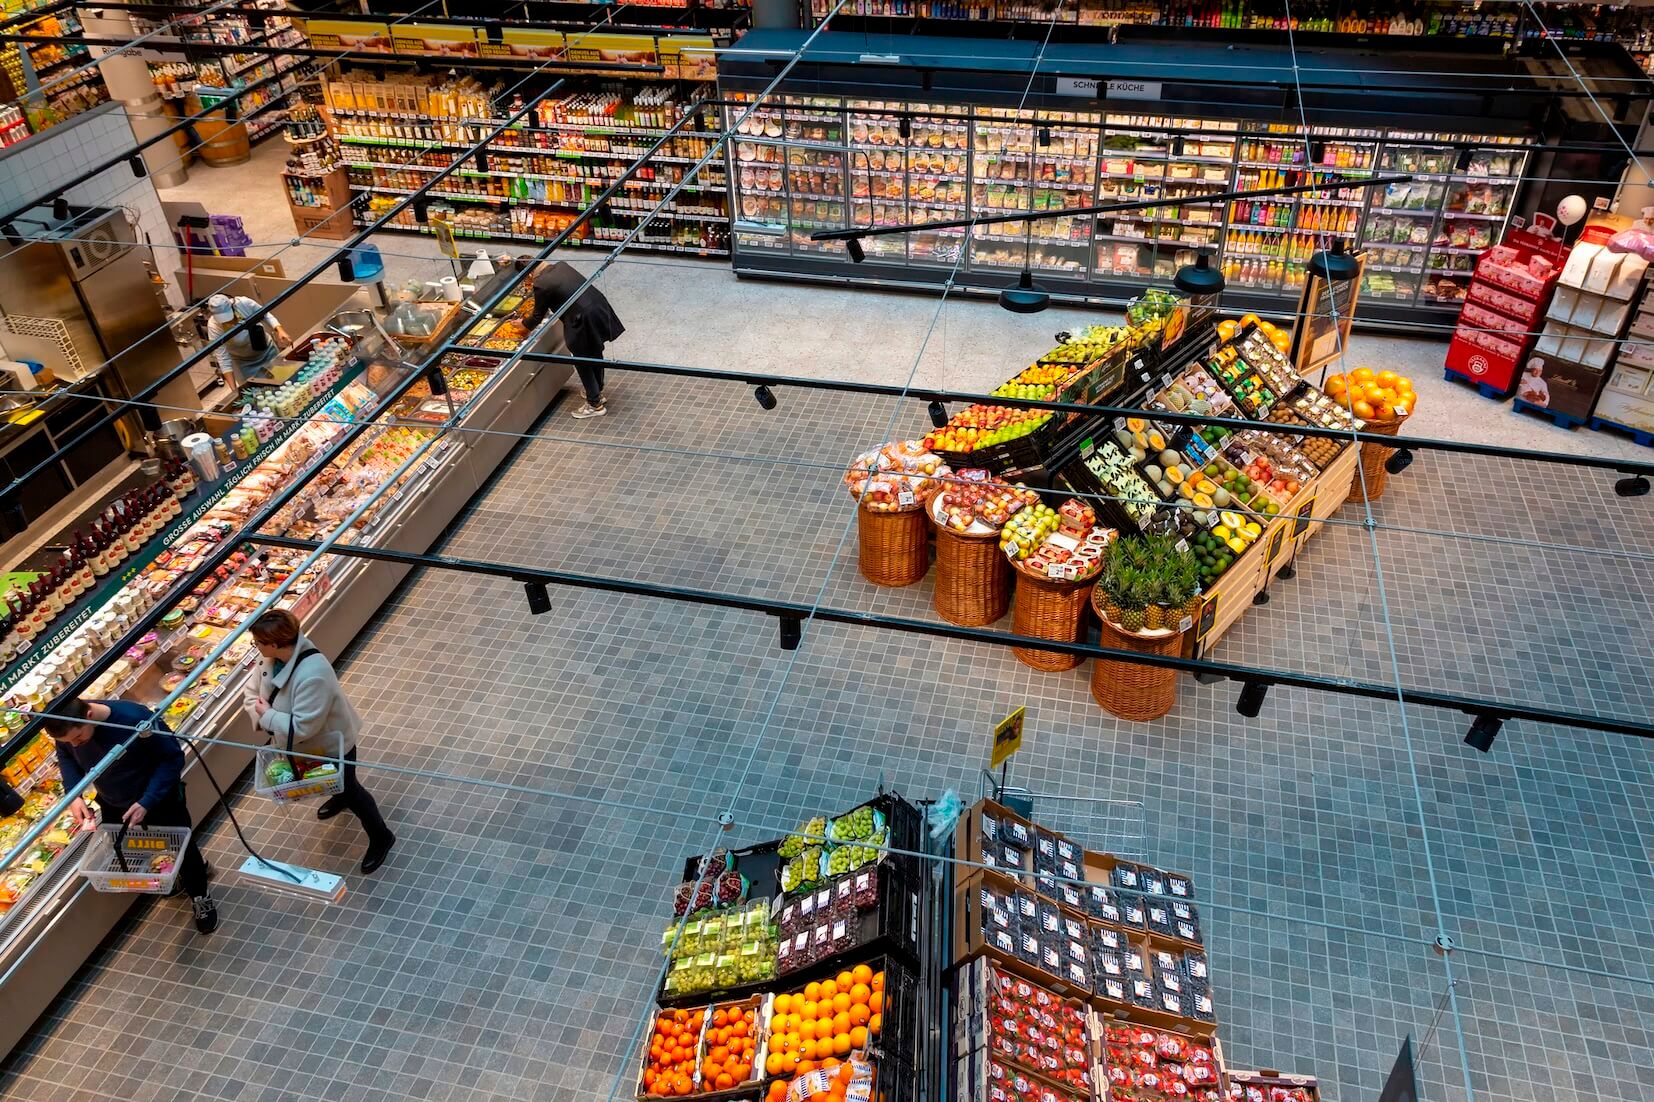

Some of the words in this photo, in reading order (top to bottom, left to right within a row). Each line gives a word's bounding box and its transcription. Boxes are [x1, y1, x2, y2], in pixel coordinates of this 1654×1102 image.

[1117, 82, 1144, 91] KÜCHE
[163, 518, 192, 546] GROSSE
[192, 489, 225, 521] AUSWAHL
[224, 464, 253, 492] TÄGLICH
[253, 442, 275, 467] FRISCH
[275, 436, 283, 445] IM
[303, 389, 335, 420] ZUBEREITET
[8, 652, 40, 684] MARKT
[41, 606, 93, 654] ZUBEREITET
